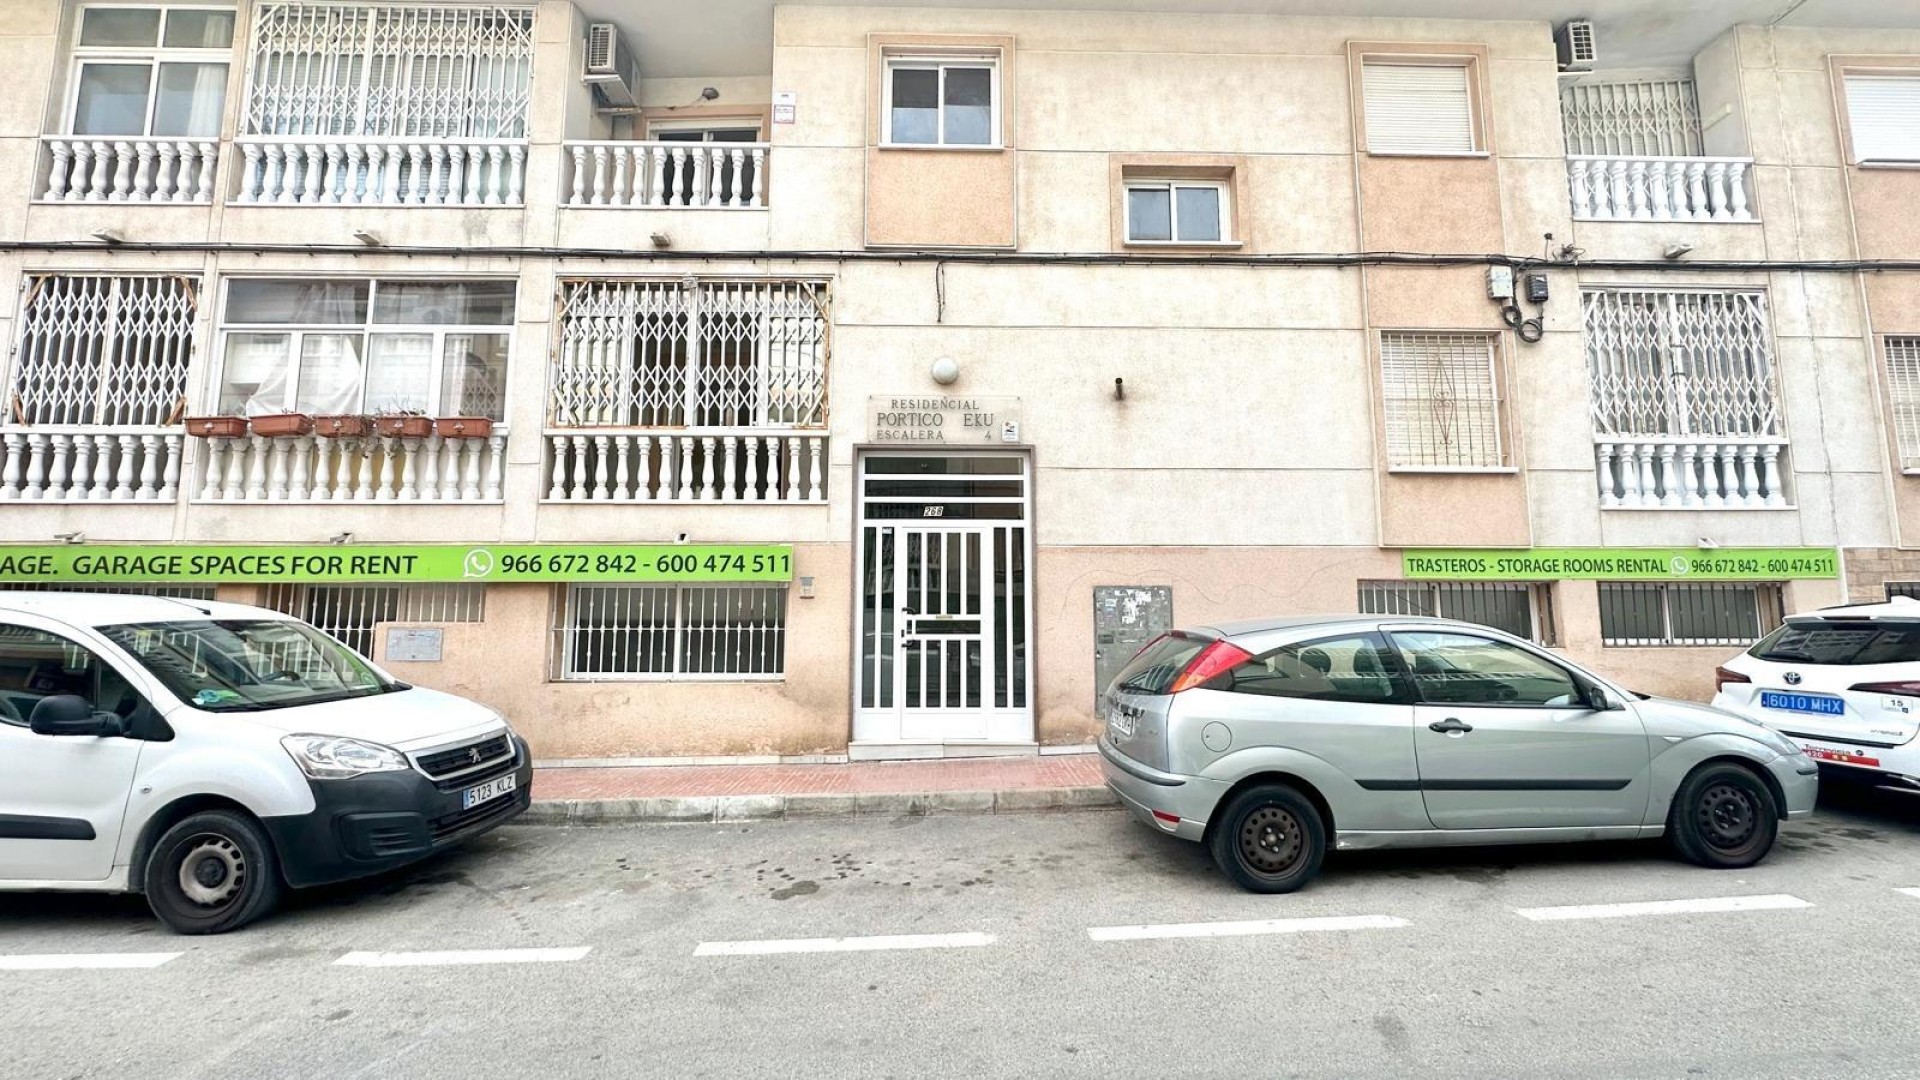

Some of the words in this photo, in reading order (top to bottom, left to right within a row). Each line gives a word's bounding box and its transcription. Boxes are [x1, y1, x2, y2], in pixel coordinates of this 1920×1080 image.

[891, 399, 980, 410] RESIDENCIAL
[876, 412, 944, 427] PORTICO
[963, 413, 994, 427] EKU
[876, 430, 944, 440] ESCALERA
[984, 430, 992, 440] 4
[0, 555, 59, 575] AGE.
[72, 555, 182, 575] GARAGE
[189, 555, 285, 575] SPACES
[291, 556, 342, 575] FOR
[350, 555, 418, 575] RENT
[501, 554, 542, 573] 966
[548, 554, 589, 573] 672
[595, 554, 637, 573] 842
[656, 554, 698, 573] 600
[703, 554, 746, 573] 474
[752, 554, 789, 573] 511
[1407, 558, 1486, 573] TRASTEROS
[1497, 558, 1560, 573] STORAGE
[1563, 558, 1614, 573] ROOMS
[1617, 558, 1667, 573] RENTAL
[1691, 559, 1712, 573] 966
[1715, 559, 1735, 573] 672
[1738, 559, 1759, 573] 842
[1768, 559, 1789, 573] 600
[1791, 559, 1812, 573] 474
[1814, 559, 1834, 573] 511
[1769, 694, 1807, 709] 6010
[1811, 697, 1842, 713] MHX
[470, 784, 492, 804] 5123
[496, 776, 513, 793] KLZ
